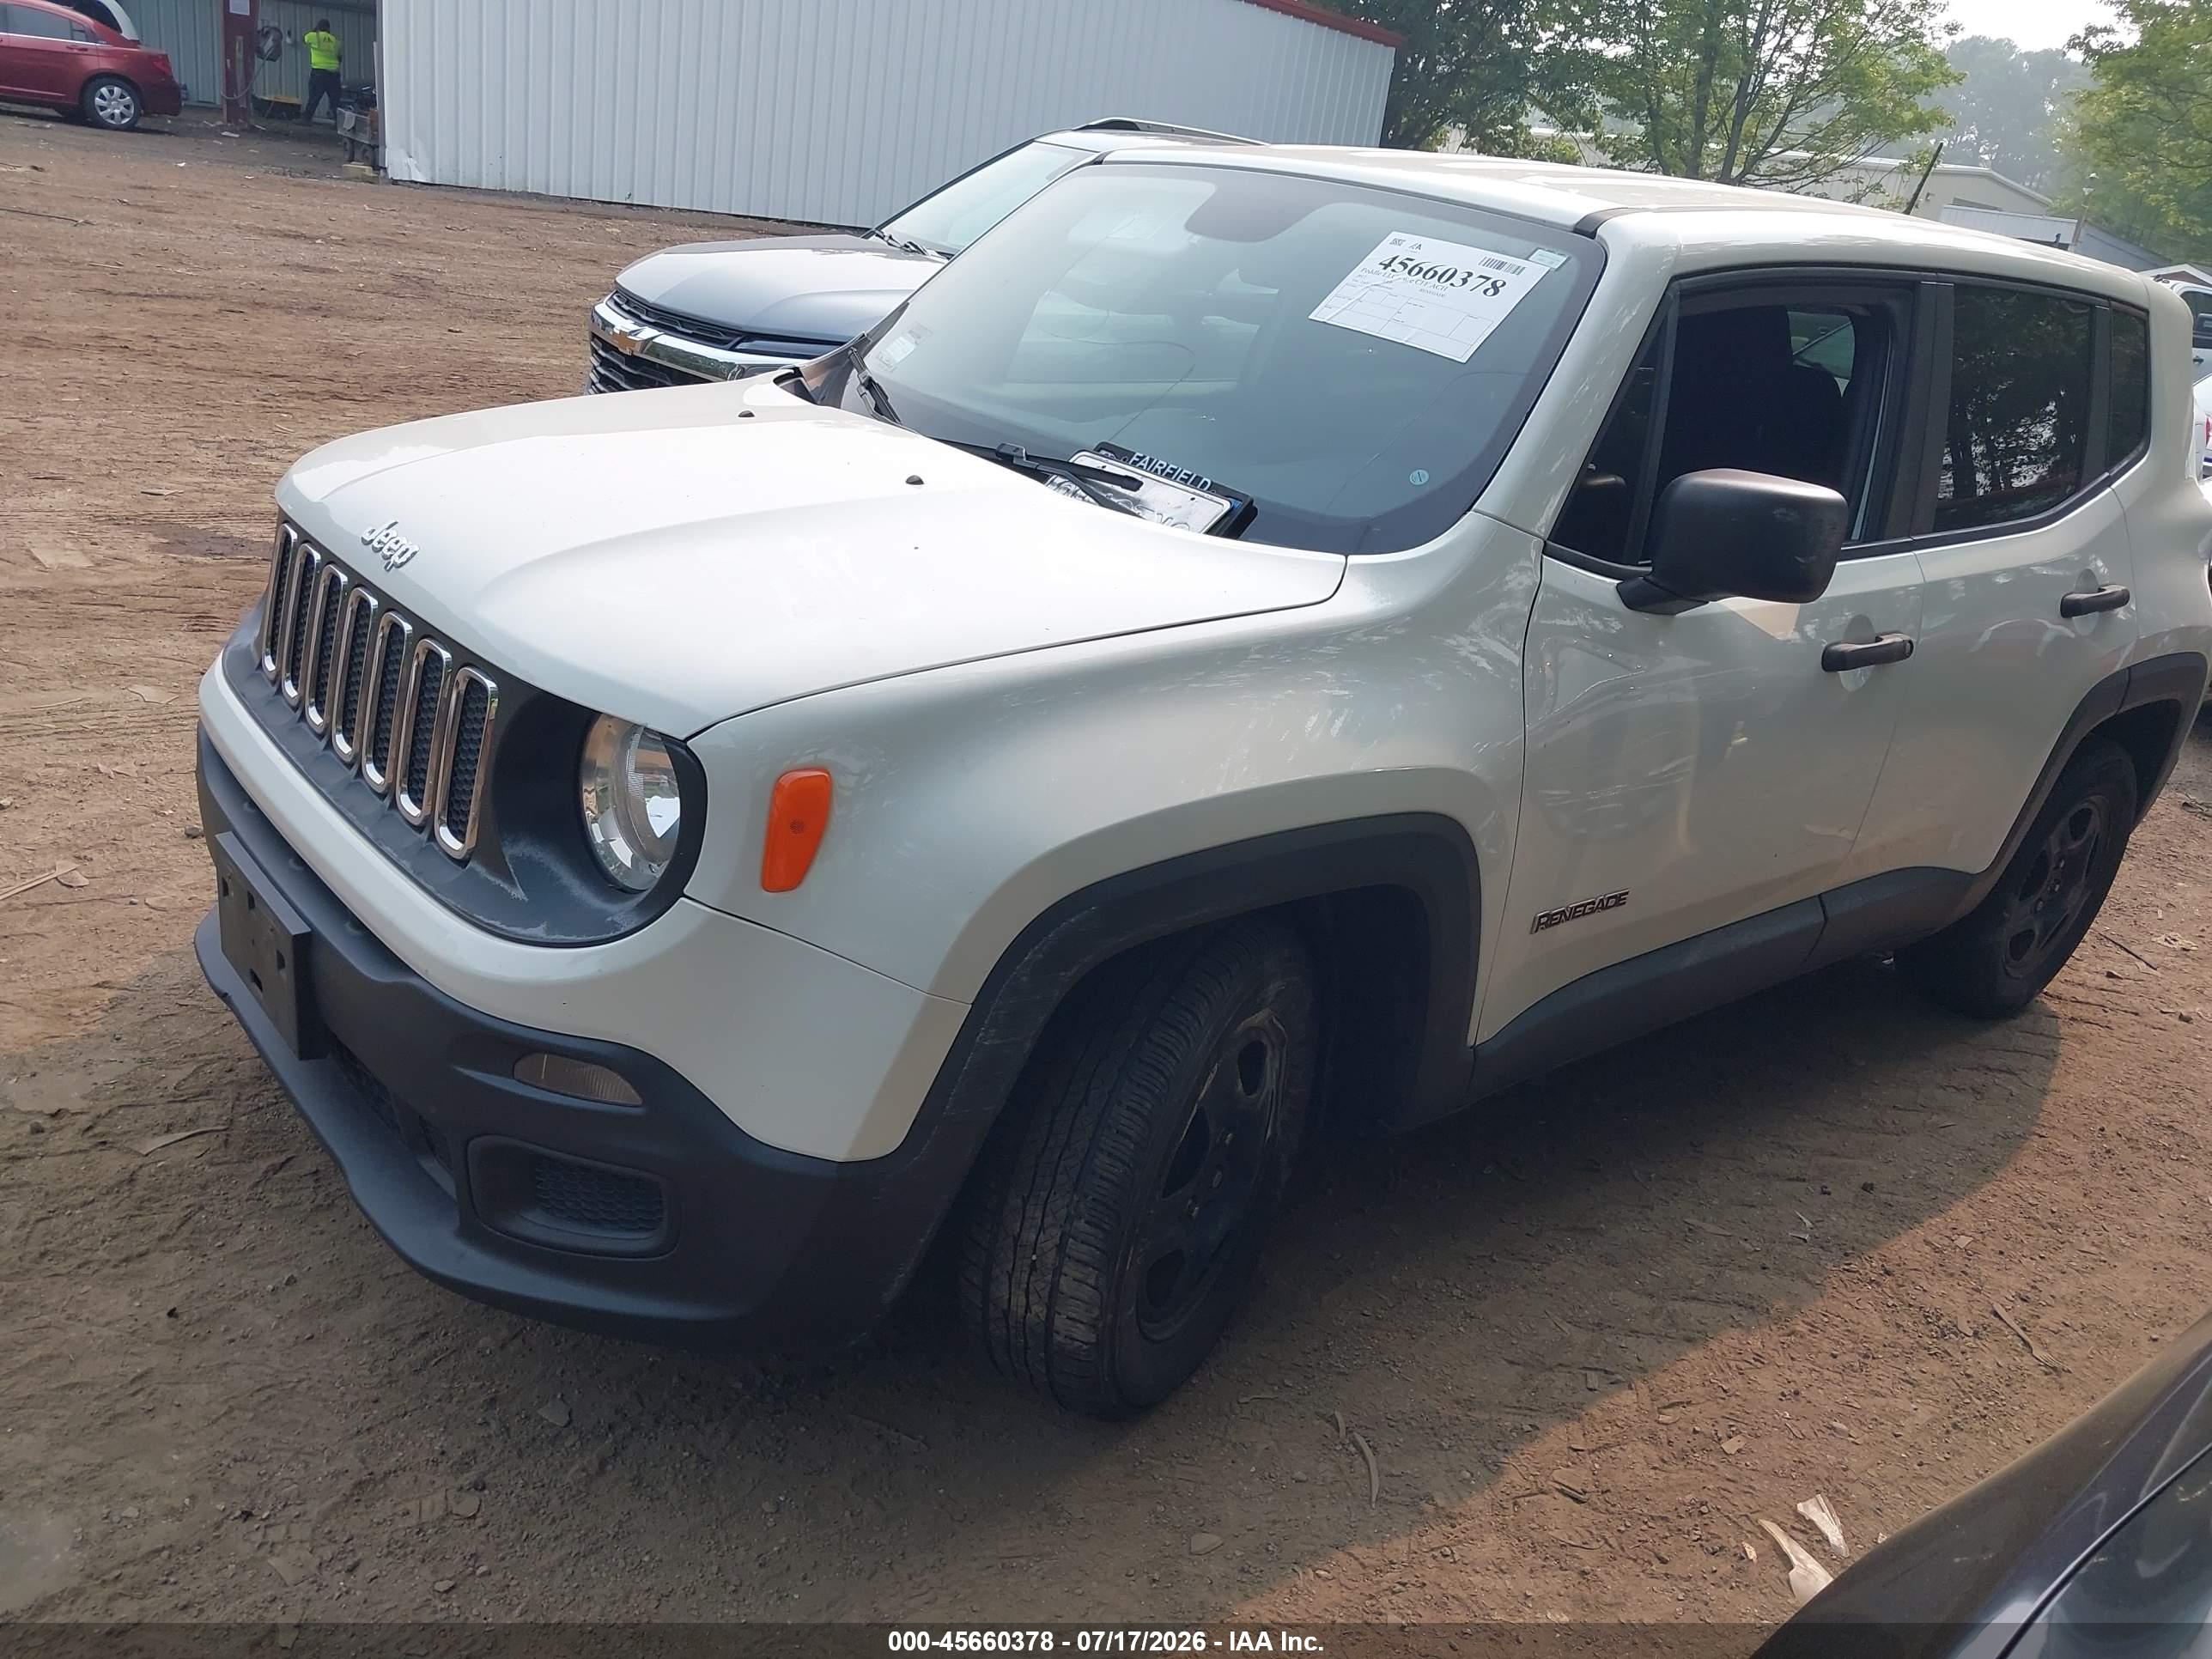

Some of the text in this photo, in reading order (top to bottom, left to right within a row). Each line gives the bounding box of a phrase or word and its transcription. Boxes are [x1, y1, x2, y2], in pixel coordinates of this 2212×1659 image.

[1377, 254, 1507, 298] 45660378
[1128, 452, 1212, 492] FAIRFIELD
[361, 520, 420, 572] Jeep
[1529, 888, 1630, 935] RENEGADE
